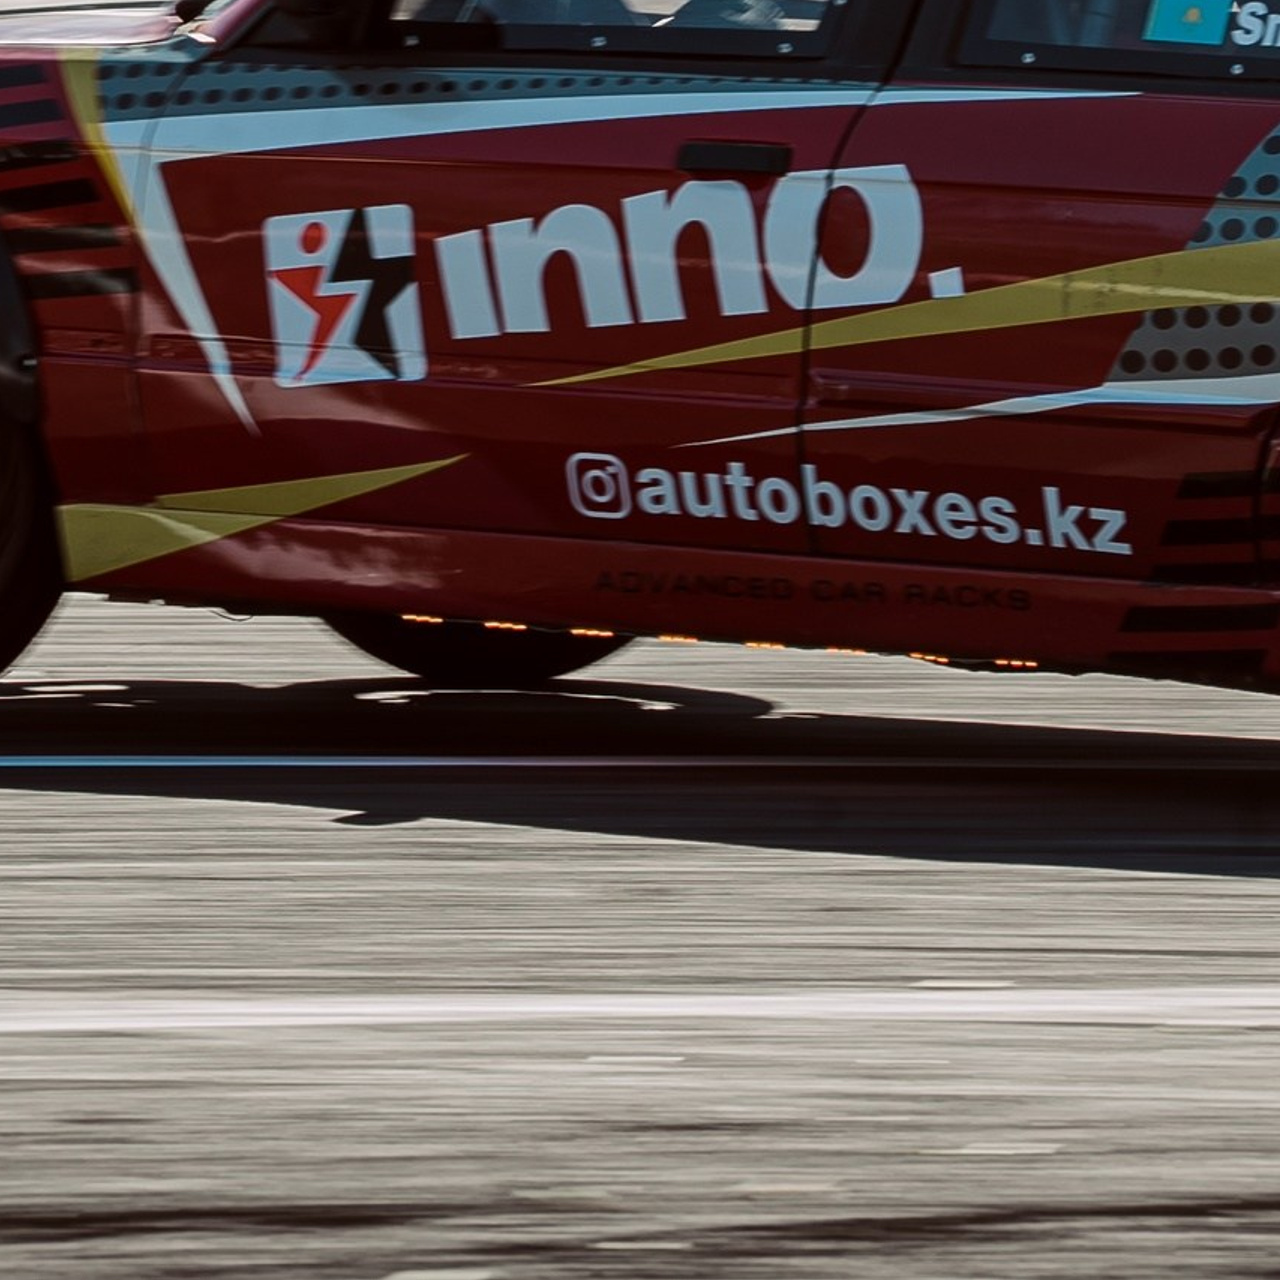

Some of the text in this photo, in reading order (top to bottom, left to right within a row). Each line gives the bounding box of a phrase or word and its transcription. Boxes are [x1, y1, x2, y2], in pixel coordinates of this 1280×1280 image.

[635, 461, 1133, 556] autoboxes.kz
[593, 569, 1033, 612] ADVANCED CAR RACKS
